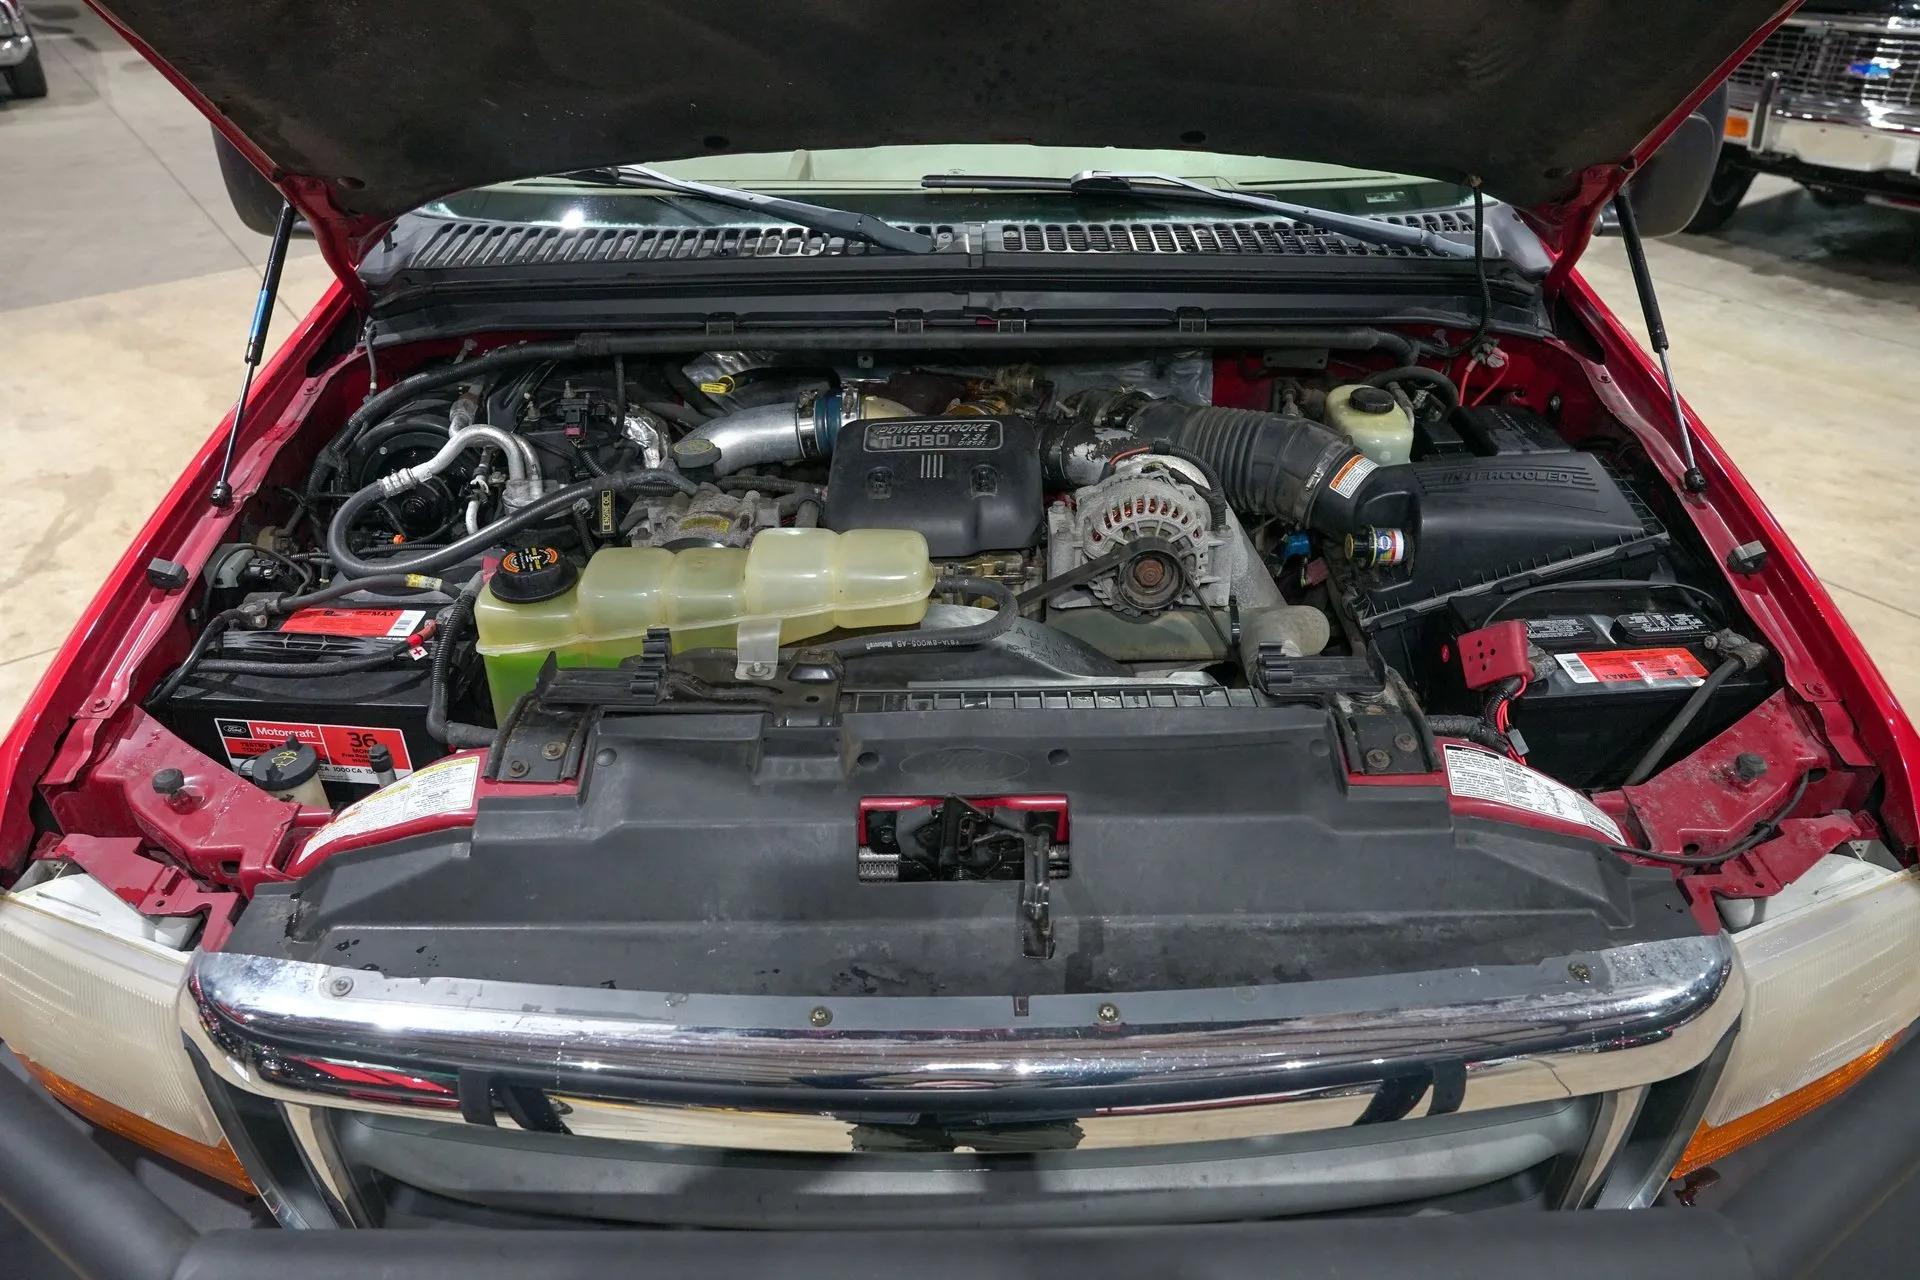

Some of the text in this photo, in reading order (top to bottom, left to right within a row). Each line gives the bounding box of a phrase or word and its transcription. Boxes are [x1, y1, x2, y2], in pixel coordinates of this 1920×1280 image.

[876, 424, 990, 434] POWER STROKE
[879, 434, 950, 449] TURBO
[256, 727, 316, 738] Motorcraft
[347, 732, 377, 748] 36
